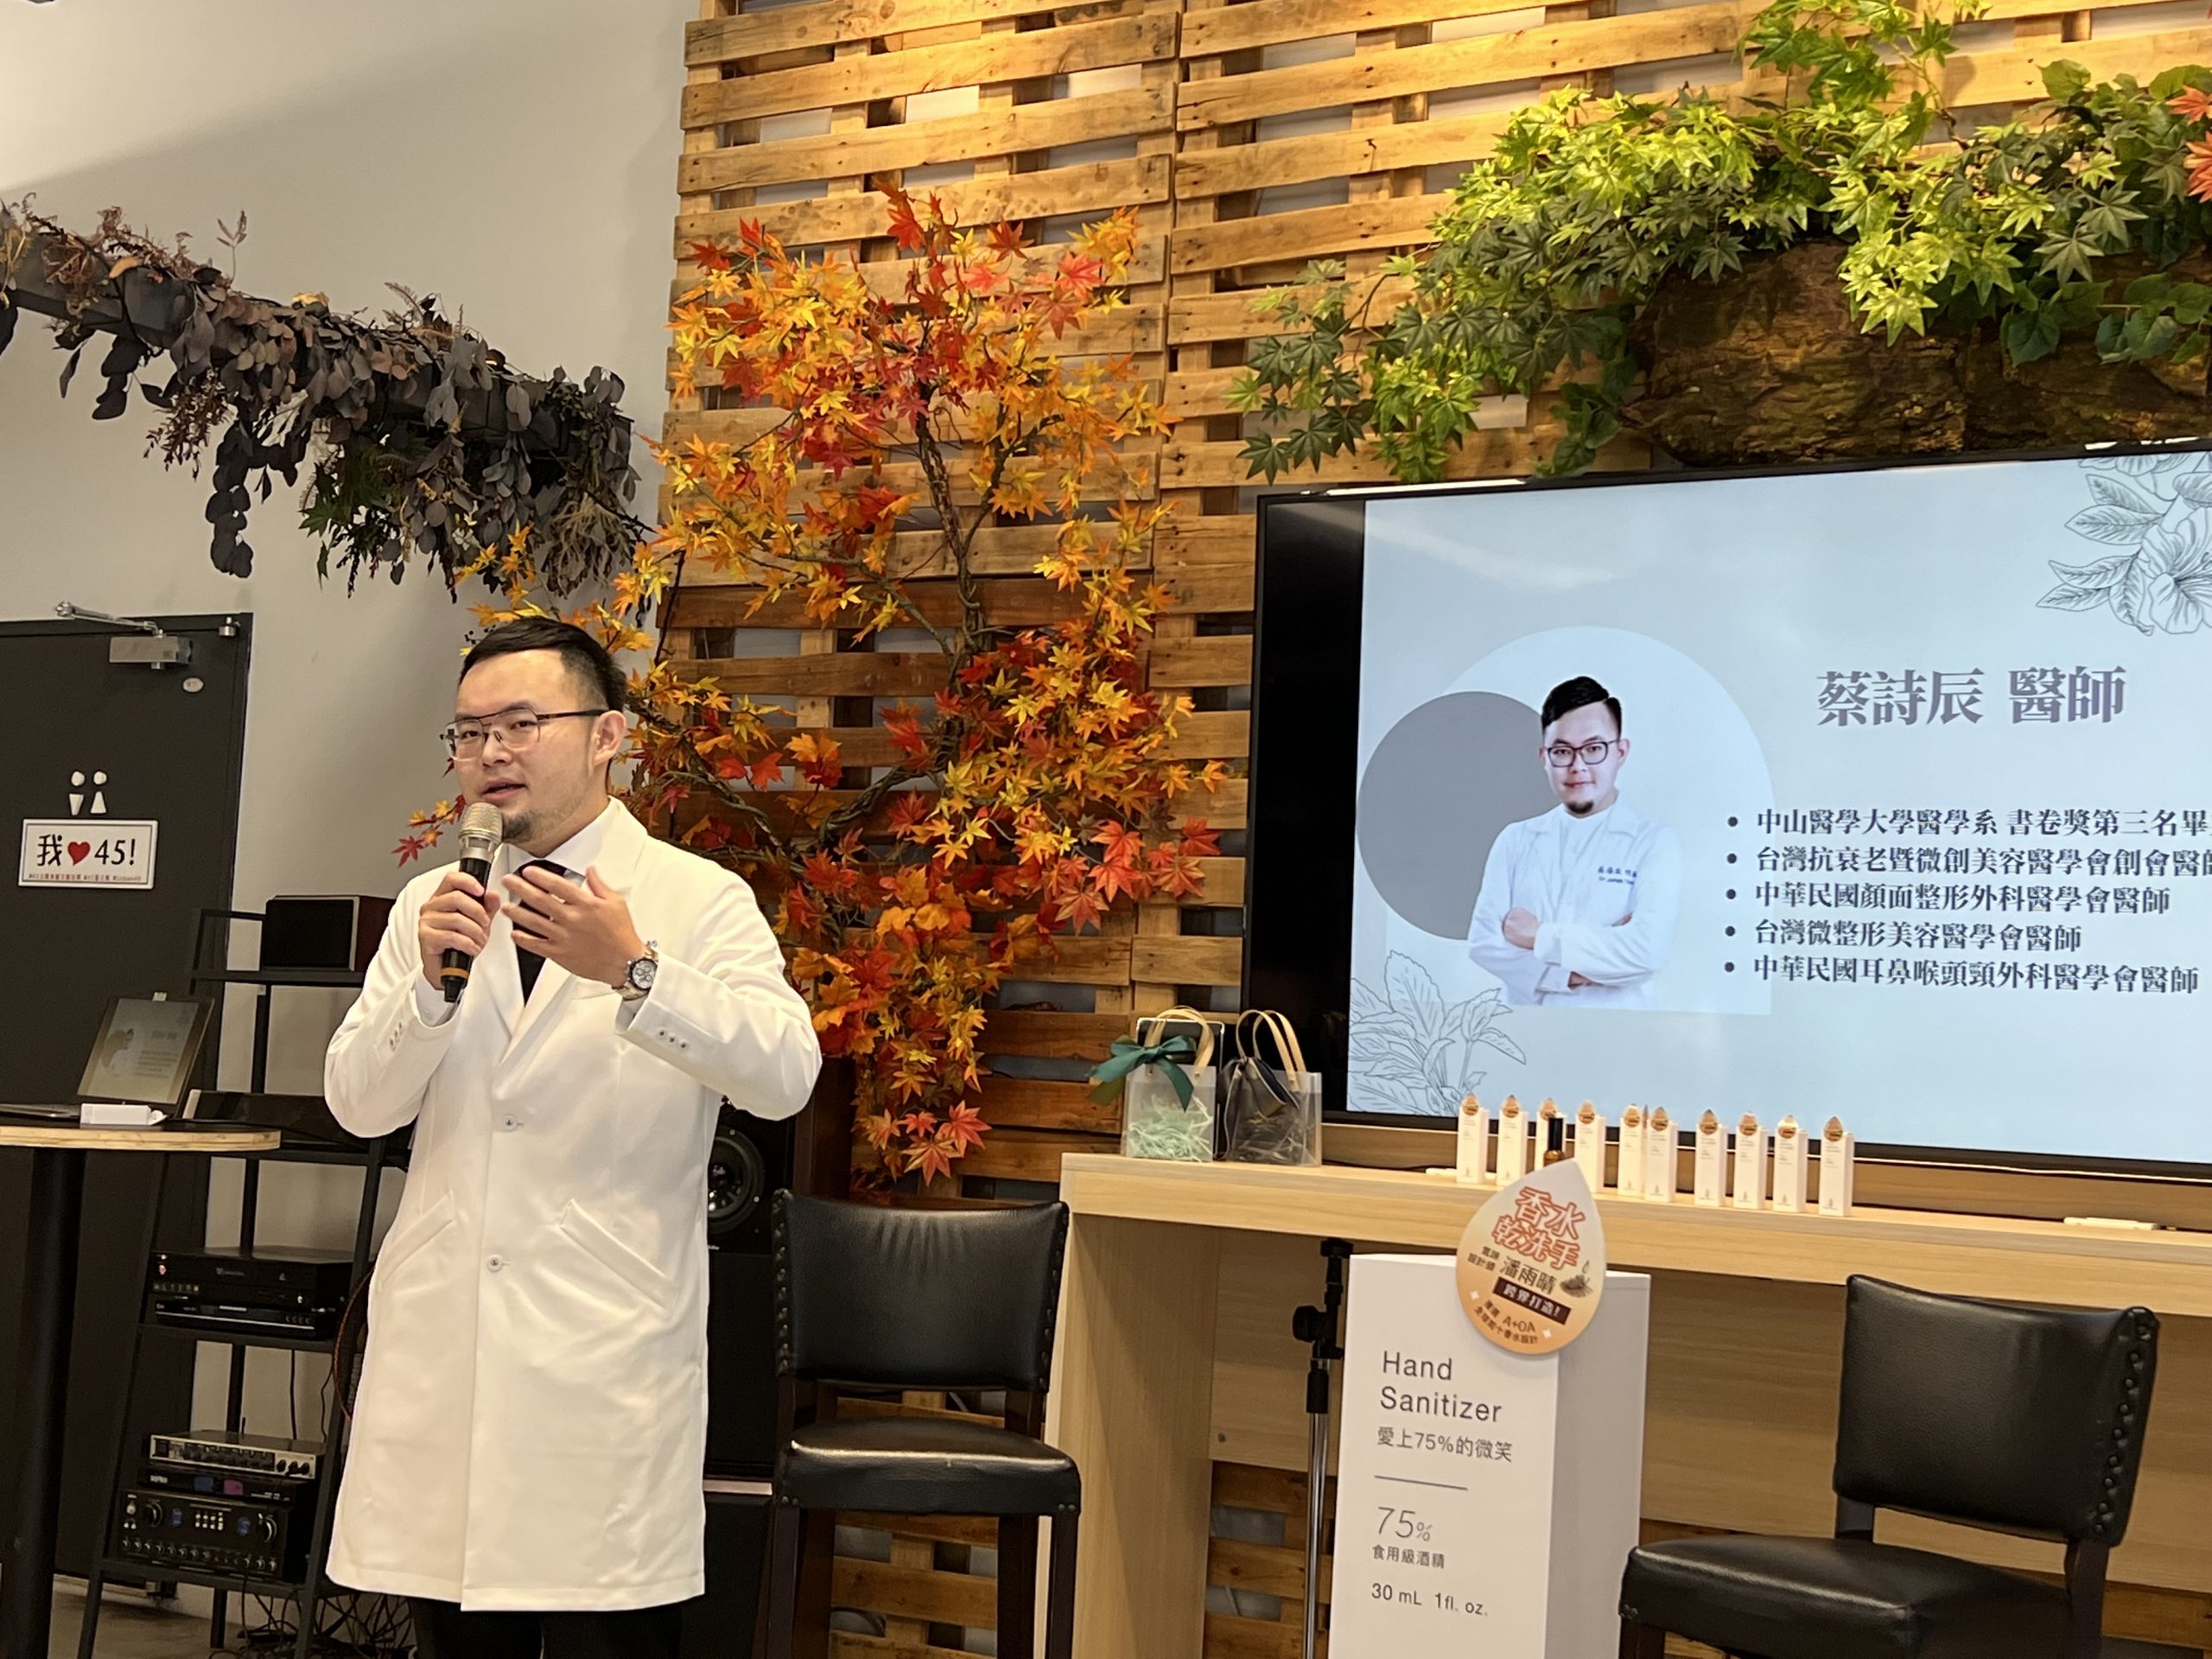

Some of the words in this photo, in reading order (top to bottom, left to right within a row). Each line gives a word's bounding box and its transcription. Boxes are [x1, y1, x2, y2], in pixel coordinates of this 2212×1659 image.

[1816, 668, 1985, 726] 蔡詩辰
[2008, 666, 2126, 723] 醫師
[1757, 808, 1998, 836] 中山醫學大學醫學系
[2005, 808, 2212, 836] 書卷獎第三名畢
[37, 834, 62, 867] 我
[94, 838, 136, 866] 45!
[1756, 880, 2170, 914] 中華民國顏面整形外科醫學會醫師
[1756, 918, 2082, 951] 台灣微整形美容醫學會醫師
[1754, 954, 2199, 994] 中華民國耳鼻喉頭頸外科醫學會醫師
[1516, 1185, 1586, 1240] 香水
[1491, 1214, 1580, 1270] 乾洗手
[1382, 1350, 1453, 1381] Hand
[1380, 1385, 1503, 1423] Sanitizer
[1377, 1426, 1513, 1462] 愛上75%的微笑
[1377, 1506, 1431, 1542] 75%
[1371, 1544, 1446, 1570] 食用級酒精
[1370, 1583, 1393, 1601] 30
[1398, 1588, 1423, 1606] mL
